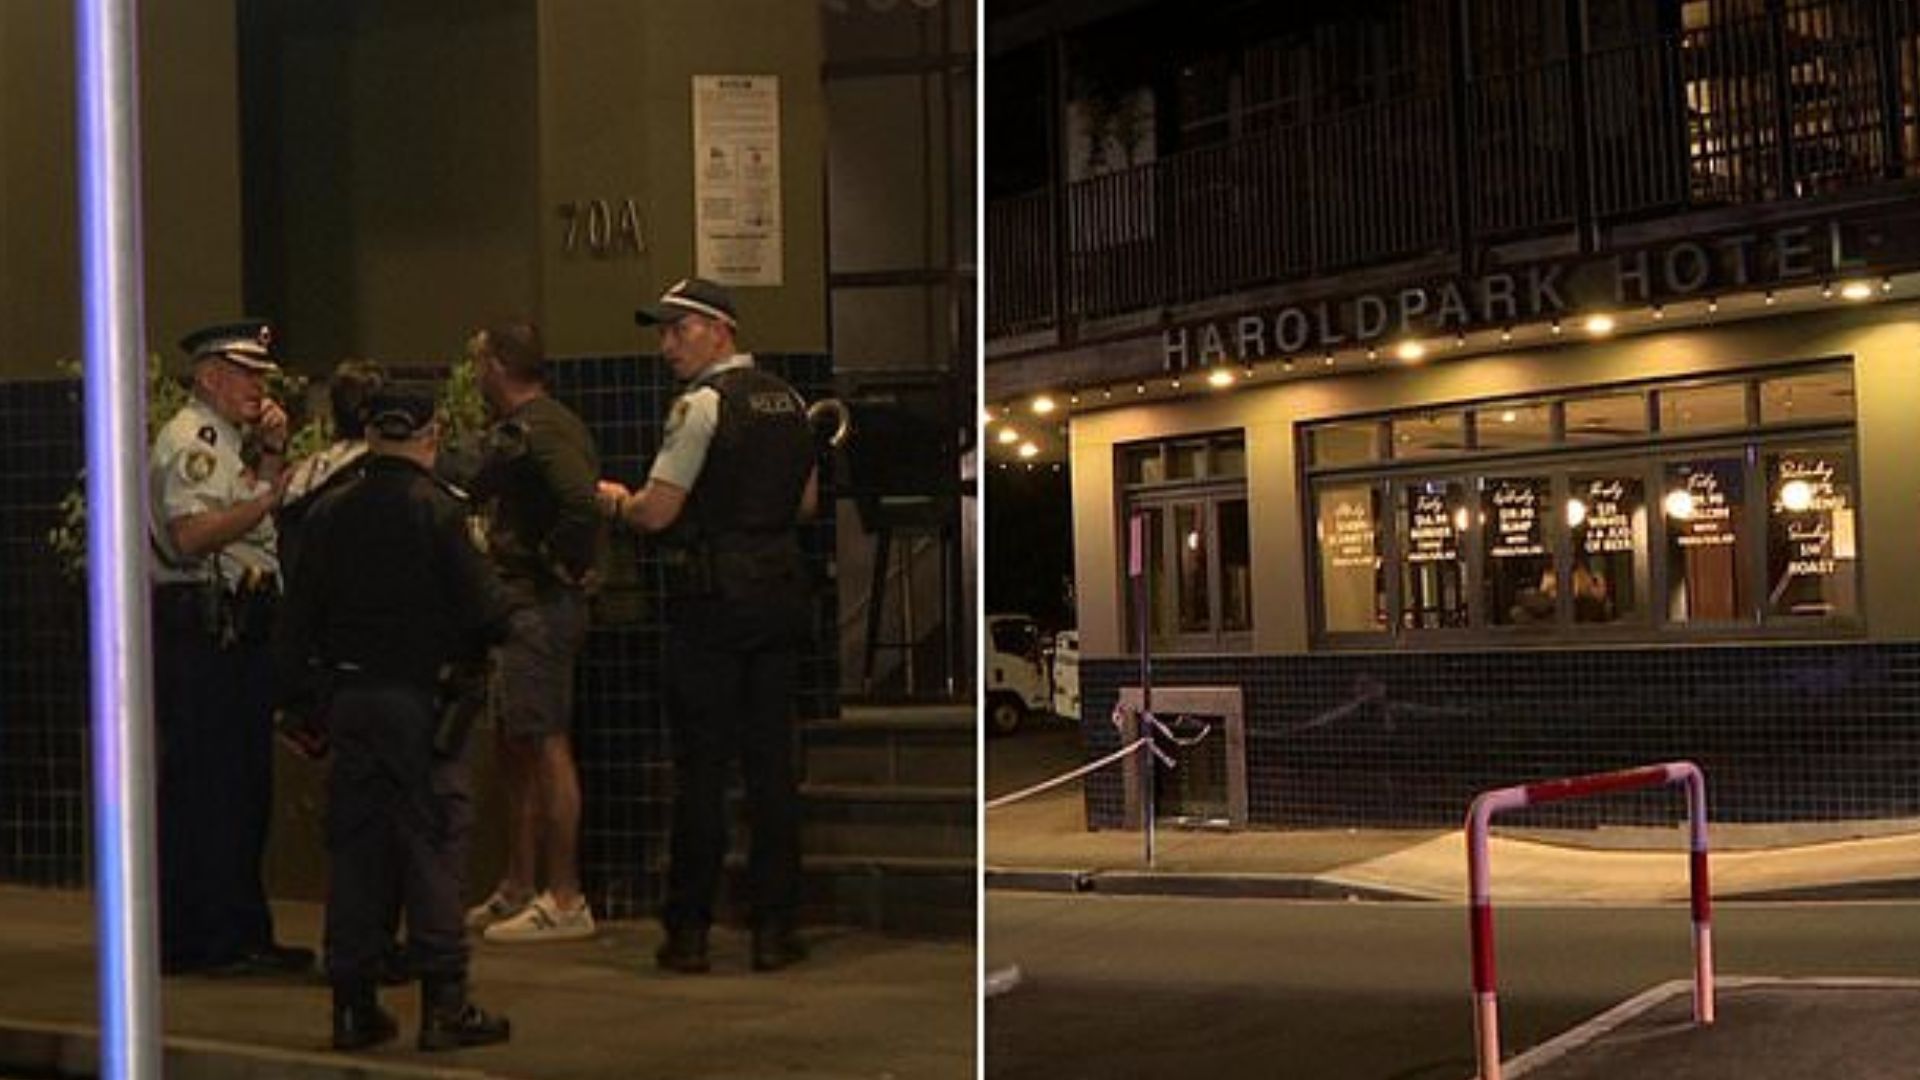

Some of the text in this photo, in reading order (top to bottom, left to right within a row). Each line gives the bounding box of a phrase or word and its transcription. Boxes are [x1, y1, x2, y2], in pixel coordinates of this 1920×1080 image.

[558, 199, 645, 253] 70A
[1162, 219, 1867, 372] HAROLDPARK HOTEL
